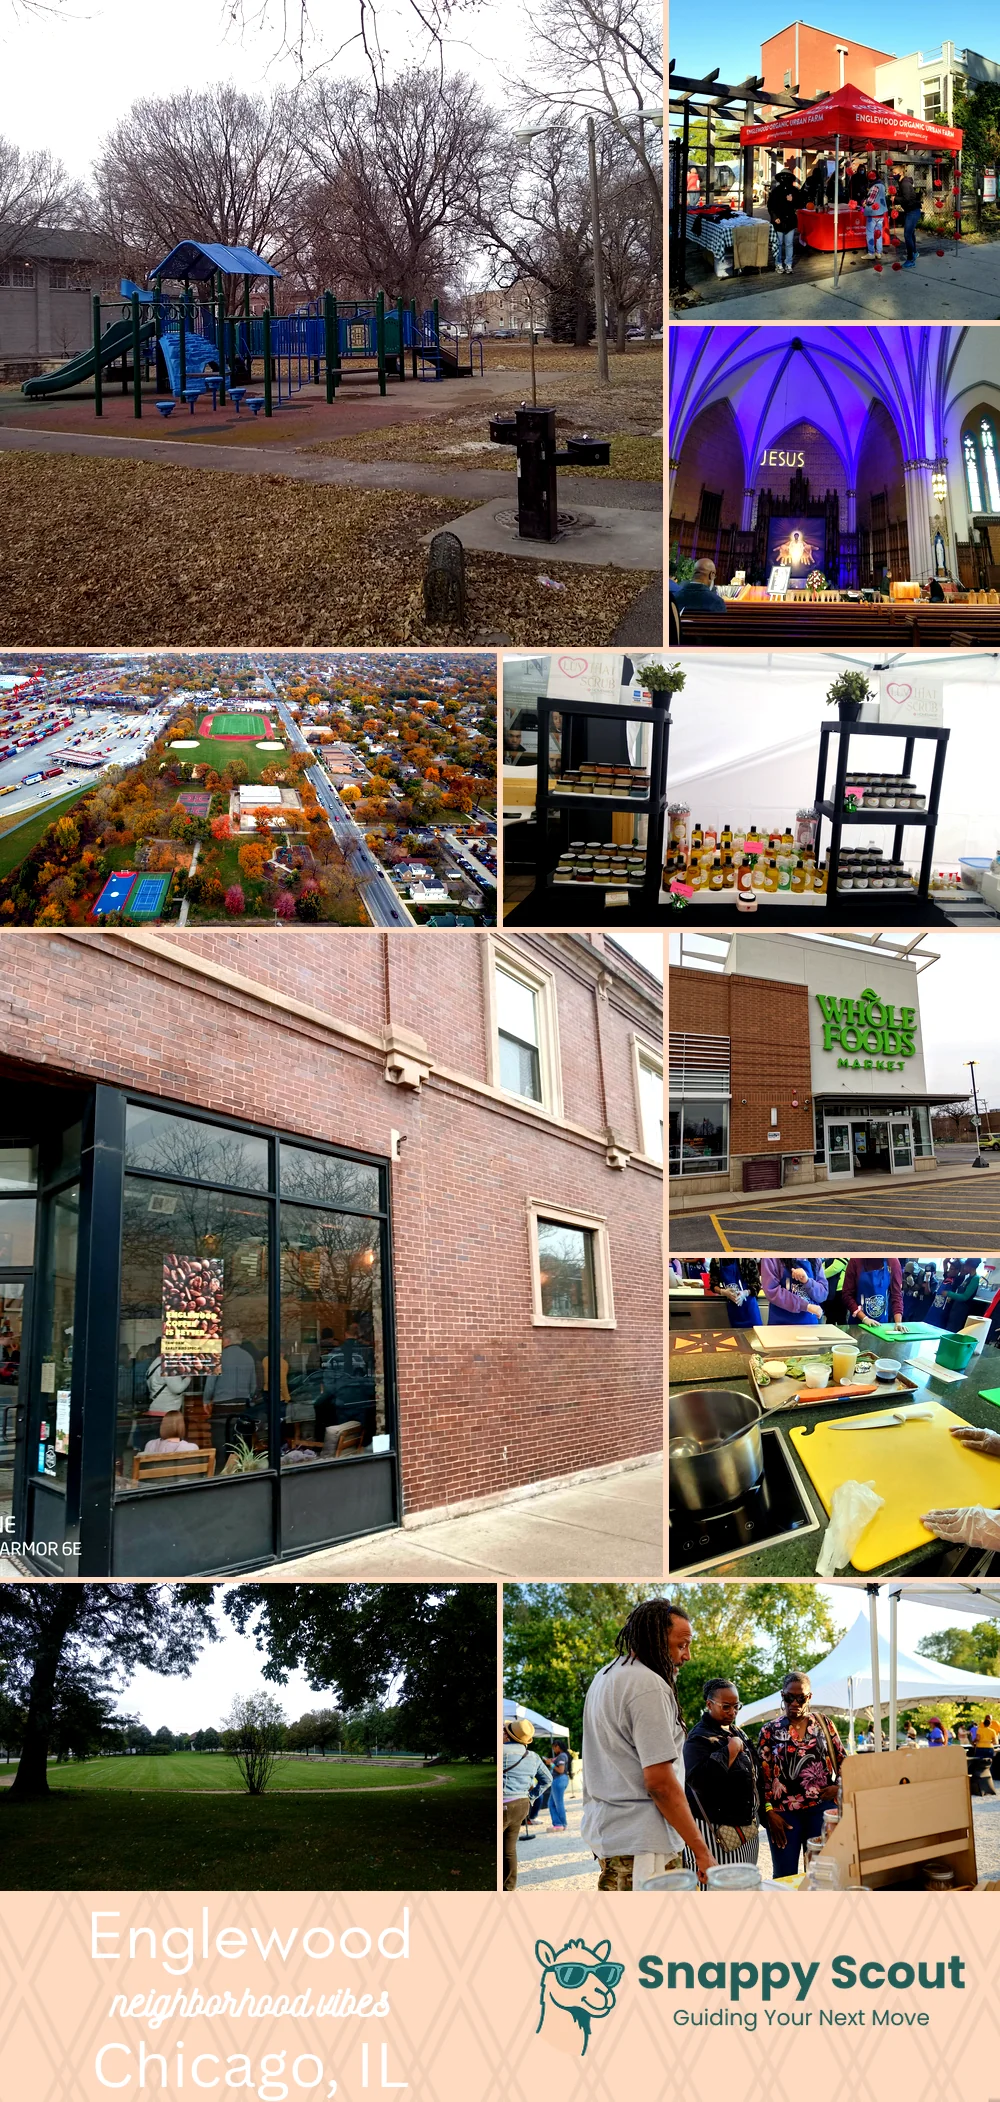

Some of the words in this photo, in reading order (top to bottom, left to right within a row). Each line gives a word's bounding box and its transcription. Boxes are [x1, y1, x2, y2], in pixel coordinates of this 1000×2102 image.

[769, 120, 789, 131] ORGANIC
[789, 117, 807, 127] URBAN
[807, 113, 824, 124] FARM
[855, 113, 899, 127] ENGLEWOOD
[899, 120, 925, 131] ORGANIC
[925, 125, 942, 135] URBAN
[942, 129, 955, 138] FARM
[760, 450, 805, 468] JESUS
[580, 676, 616, 690] SCRUB
[905, 700, 938, 713] SCRUB
[816, 993, 918, 1031] WHOLE
[822, 1023, 917, 1057] FOODS
[837, 1058, 906, 1072] MARKET
[166, 1311, 218, 1319] ENGLEWOOD
[165, 1320, 197, 1328] COFFEE
